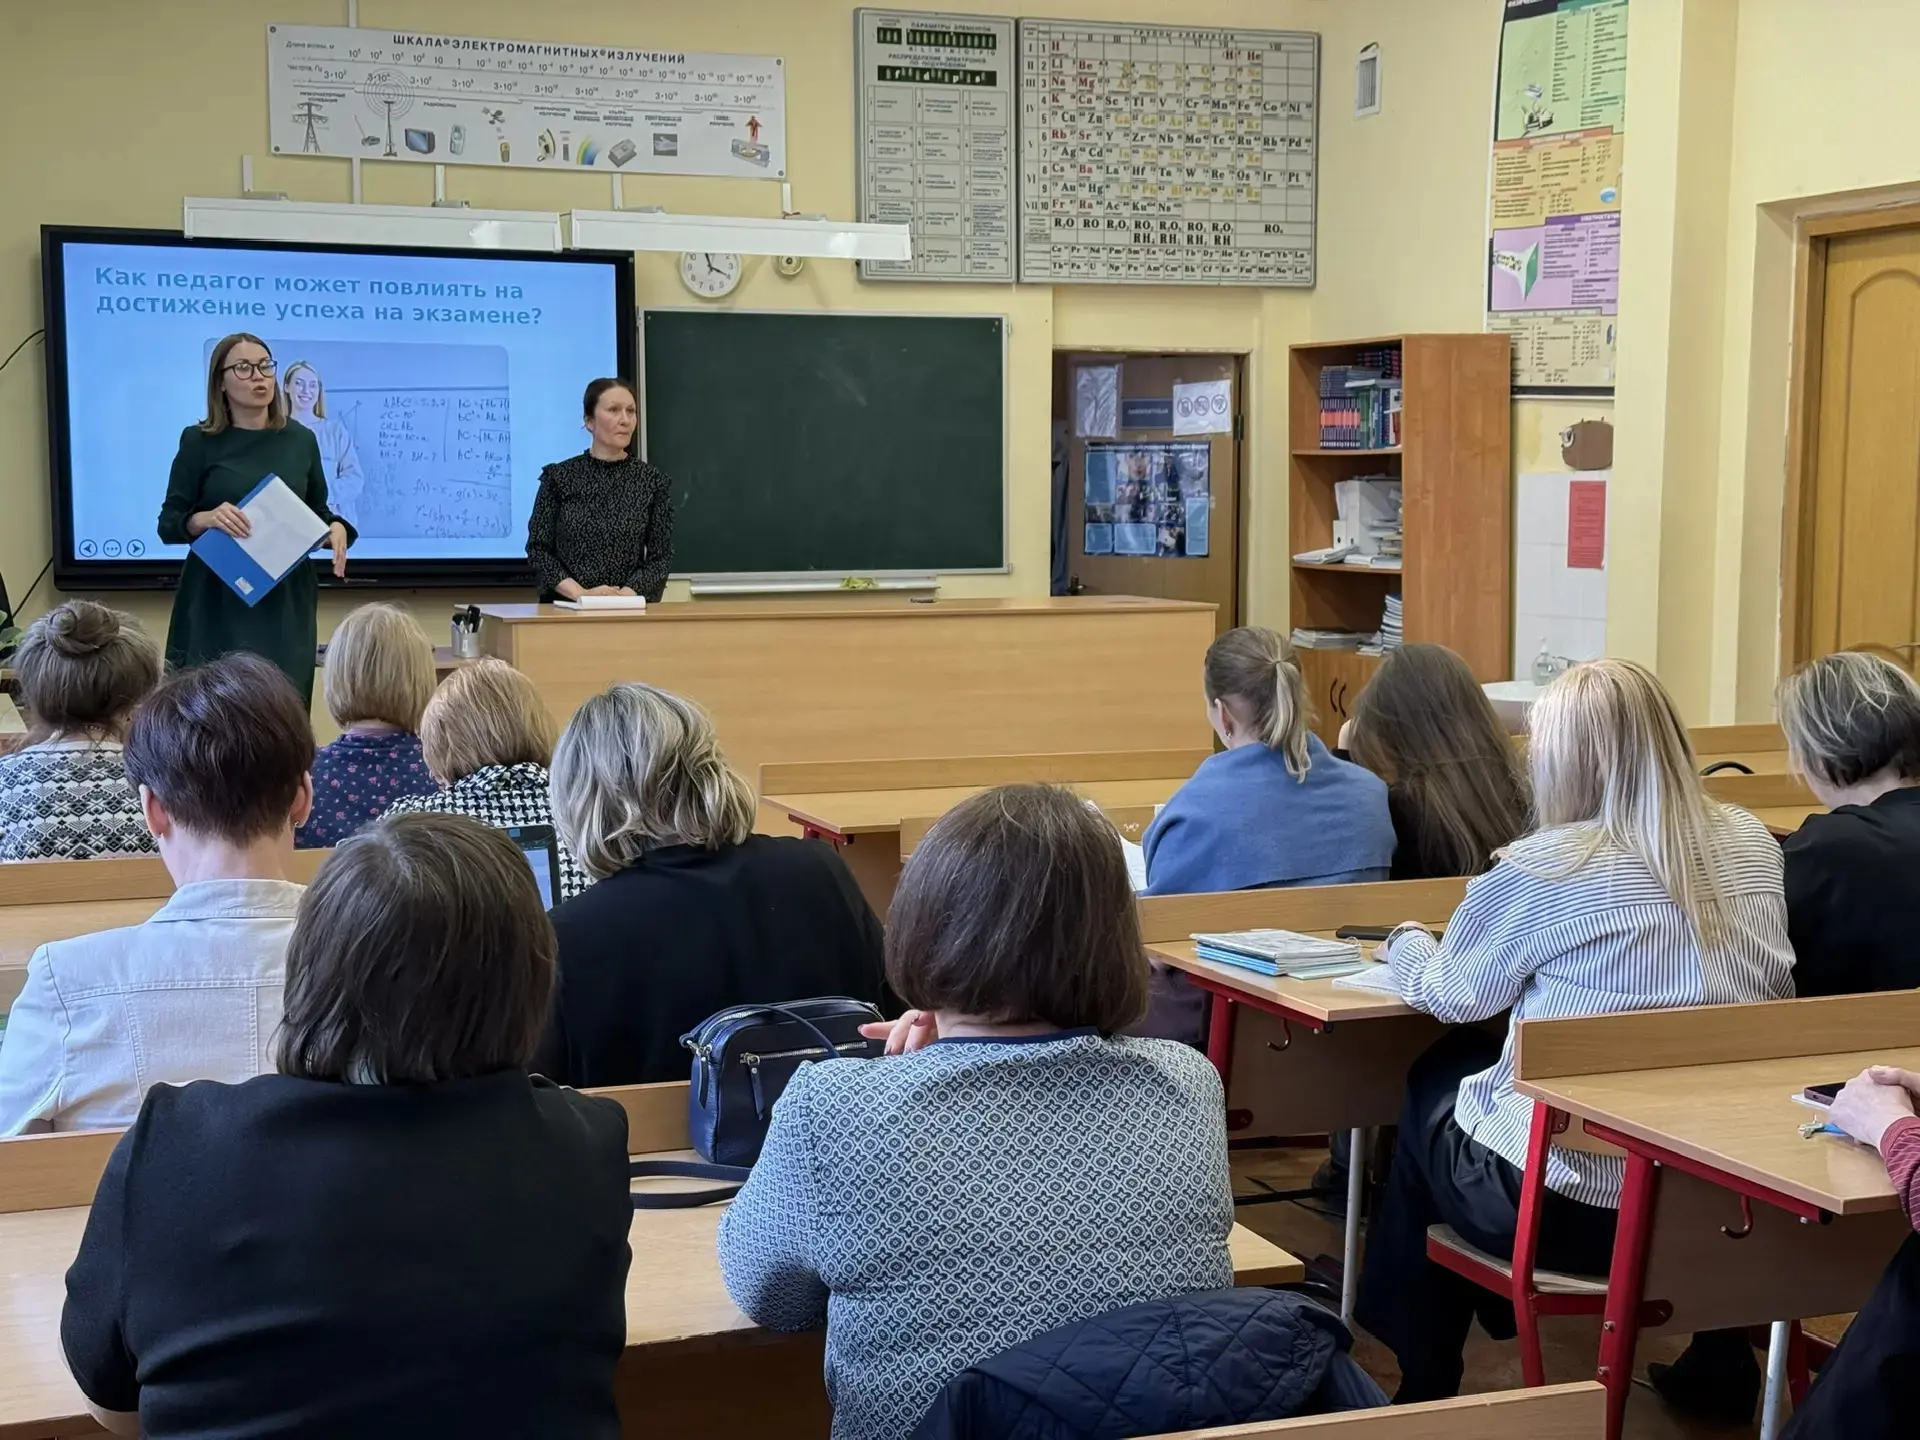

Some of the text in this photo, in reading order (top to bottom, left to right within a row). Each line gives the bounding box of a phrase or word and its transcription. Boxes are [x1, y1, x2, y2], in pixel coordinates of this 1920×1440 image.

[393, 34, 685, 64] ШКАЛА ЭЛЕКТРОМАГНИТНЫХ ИЗЛУЧЕНИЙ
[435, 56, 443, 64] 10
[1186, 99, 1199, 109] Cr
[1263, 102, 1278, 112] Co
[1061, 111, 1076, 122] Cu
[1052, 129, 1067, 139] Rb
[1078, 130, 1091, 140] Sr
[1132, 132, 1146, 142] Zr
[1159, 134, 1174, 143] Nb
[1185, 135, 1202, 145] Mo
[1237, 136, 1252, 146] Ru
[1288, 137, 1302, 147] Pd
[1061, 147, 1076, 158] Ag
[1088, 147, 1103, 158] Cd
[1079, 164, 1093, 174] Ba
[1185, 168, 1196, 177] W
[1061, 182, 1076, 192] Au
[1041, 202, 1049, 211] 10
[1083, 219, 1099, 228] RO
[1214, 235, 1231, 246] RH
[95, 267, 523, 299] Как педагог может повлиять на
[96, 296, 542, 325] достижение успеха на экзамене?
